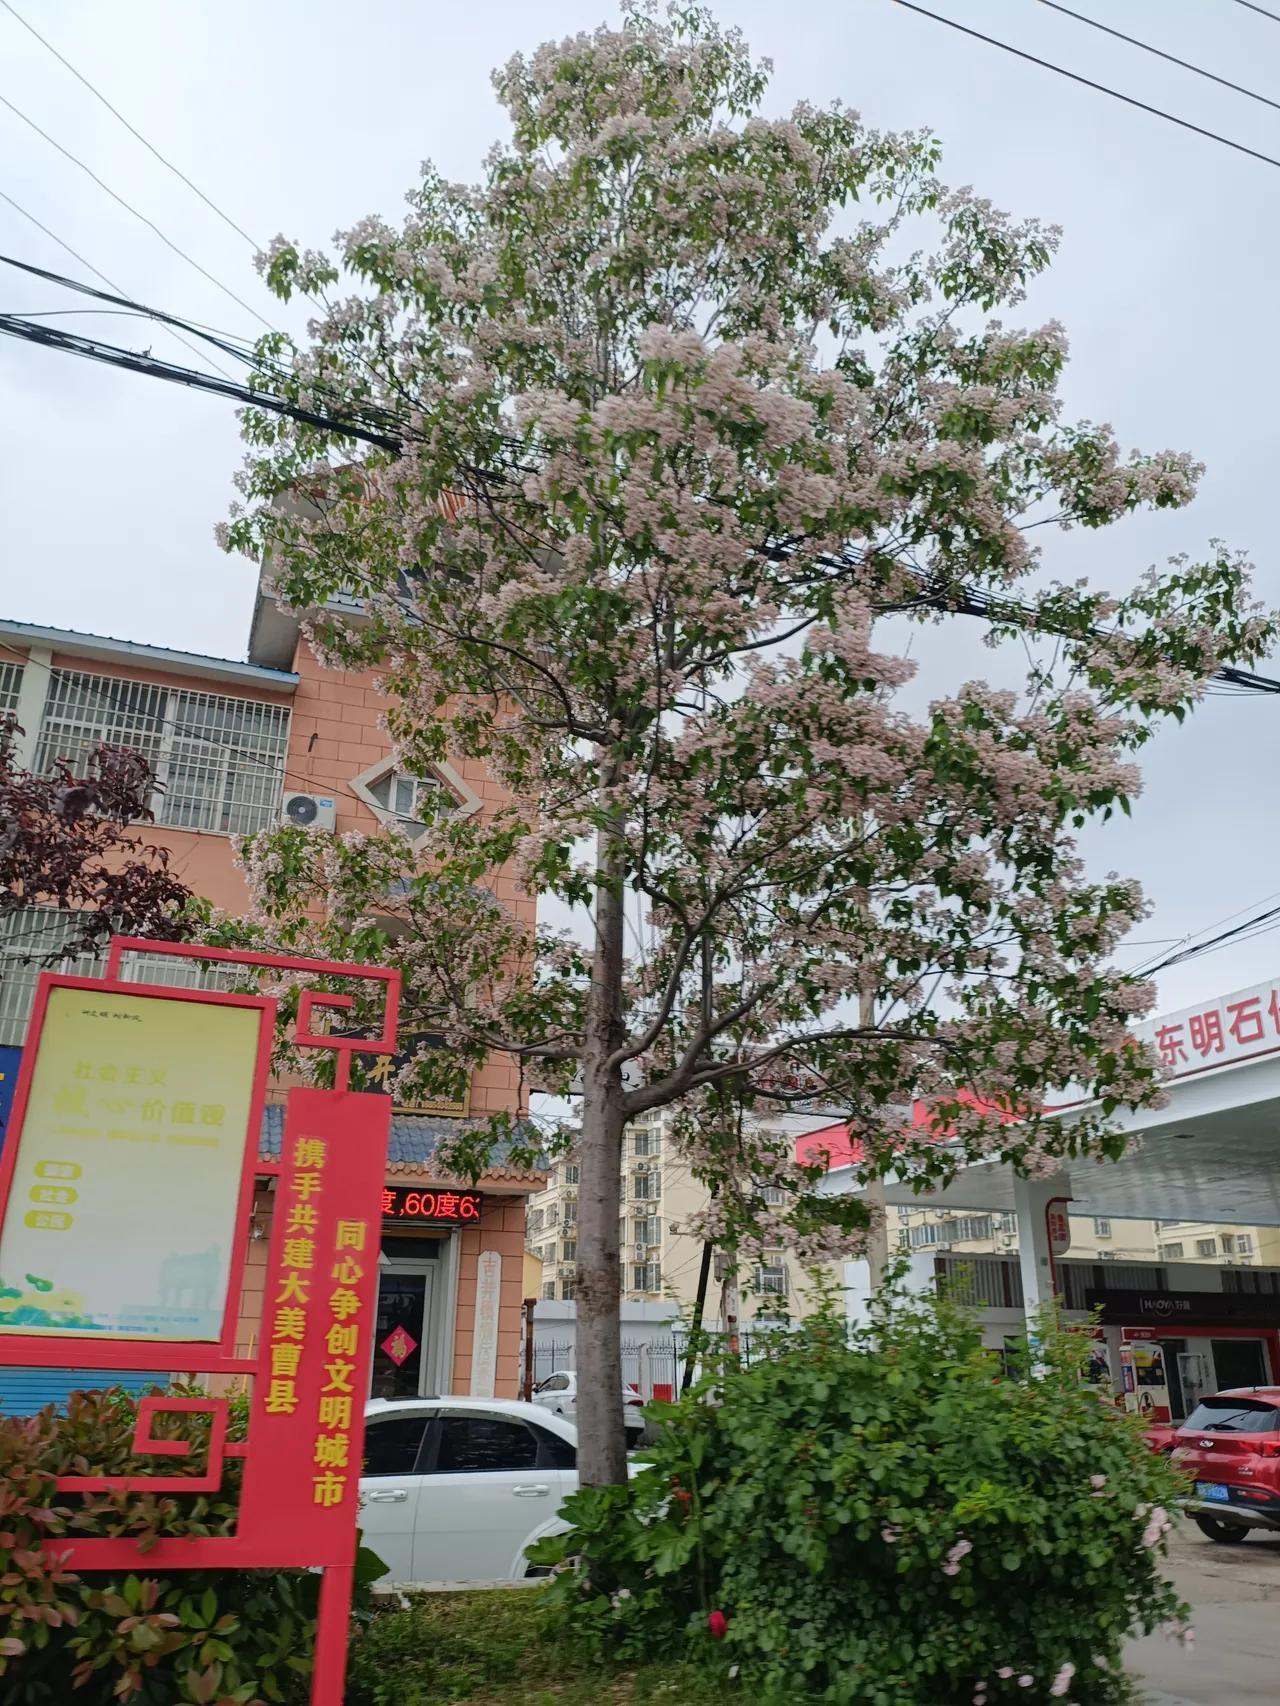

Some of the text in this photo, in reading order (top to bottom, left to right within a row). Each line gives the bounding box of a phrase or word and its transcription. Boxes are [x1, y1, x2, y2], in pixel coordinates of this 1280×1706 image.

[264, 1137, 327, 1413] 携手共建大美曹县
[312, 1219, 367, 1507] 同心争创文明城市
